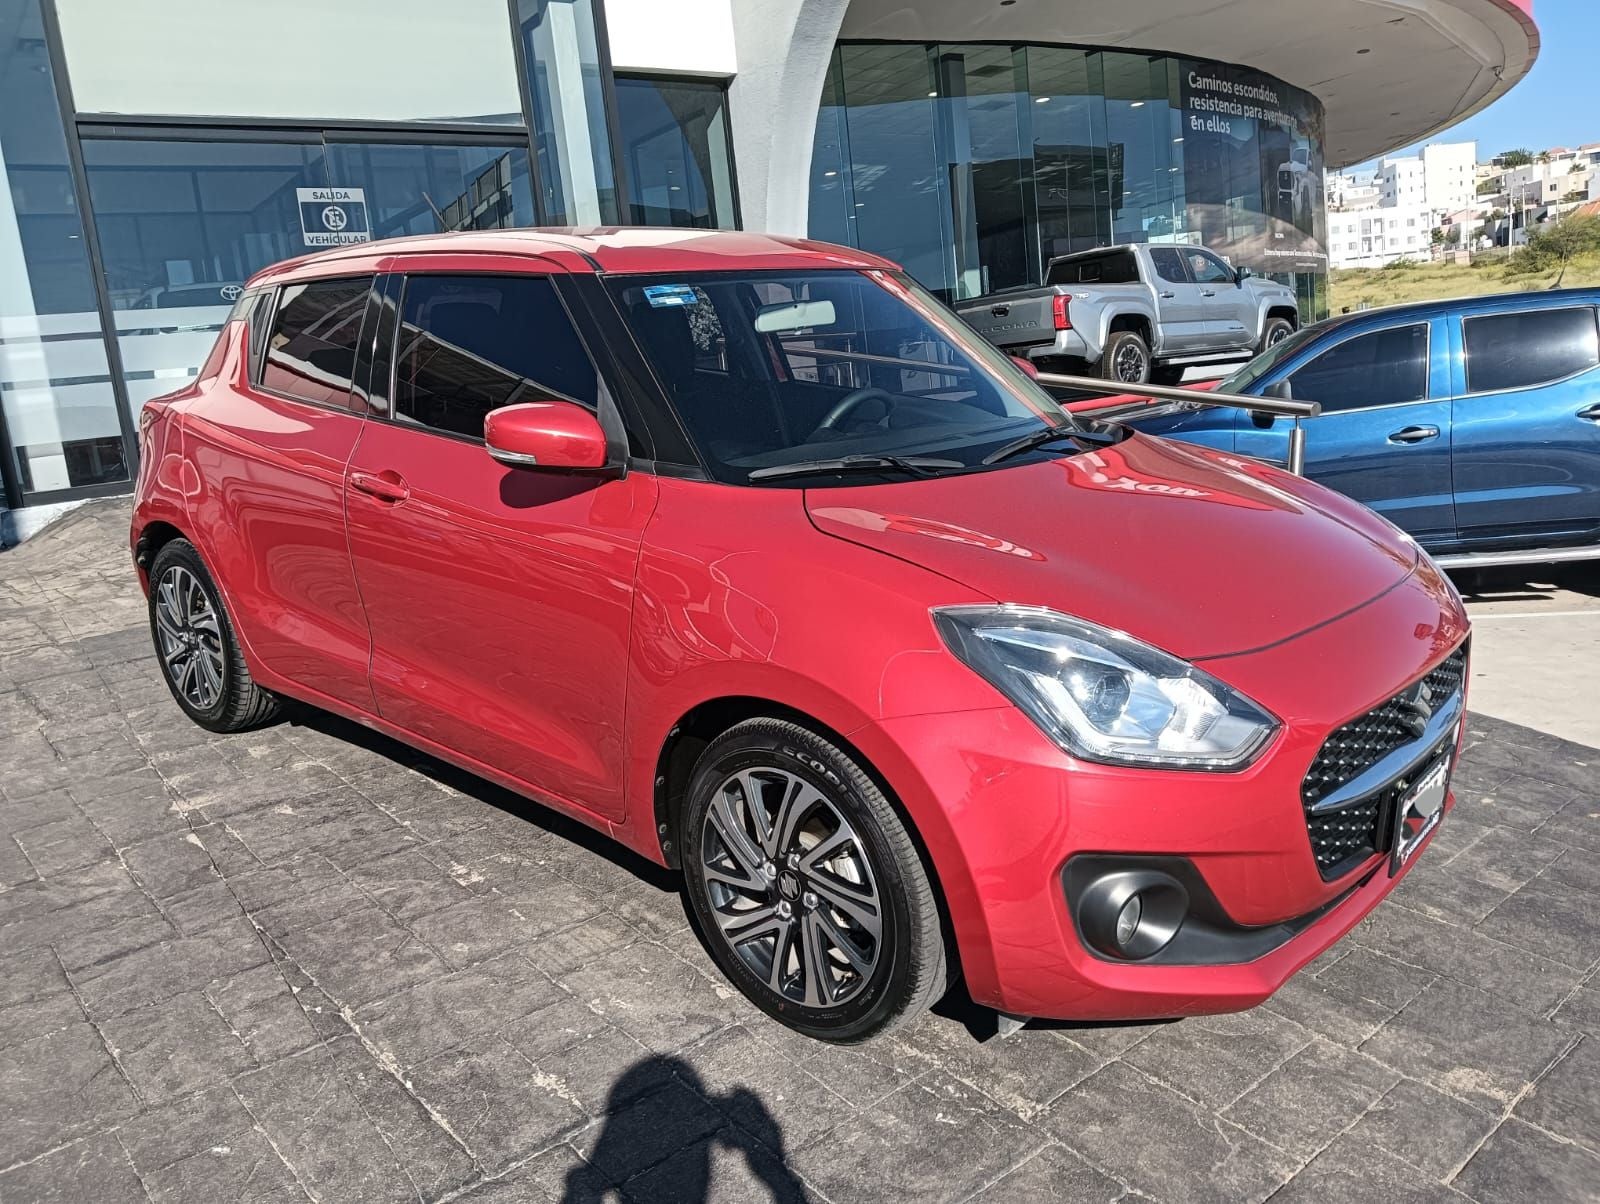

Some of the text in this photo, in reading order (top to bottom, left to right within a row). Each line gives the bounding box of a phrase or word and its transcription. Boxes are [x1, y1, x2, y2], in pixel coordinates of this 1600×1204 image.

[1188, 71, 1280, 107] Caminos escondidos,
[1190, 93, 1243, 116] resistencia
[1243, 104, 1263, 121] para
[1191, 114, 1231, 134] en ellos
[312, 191, 351, 200] SALIDA
[979, 320, 1038, 334] ACOMA
